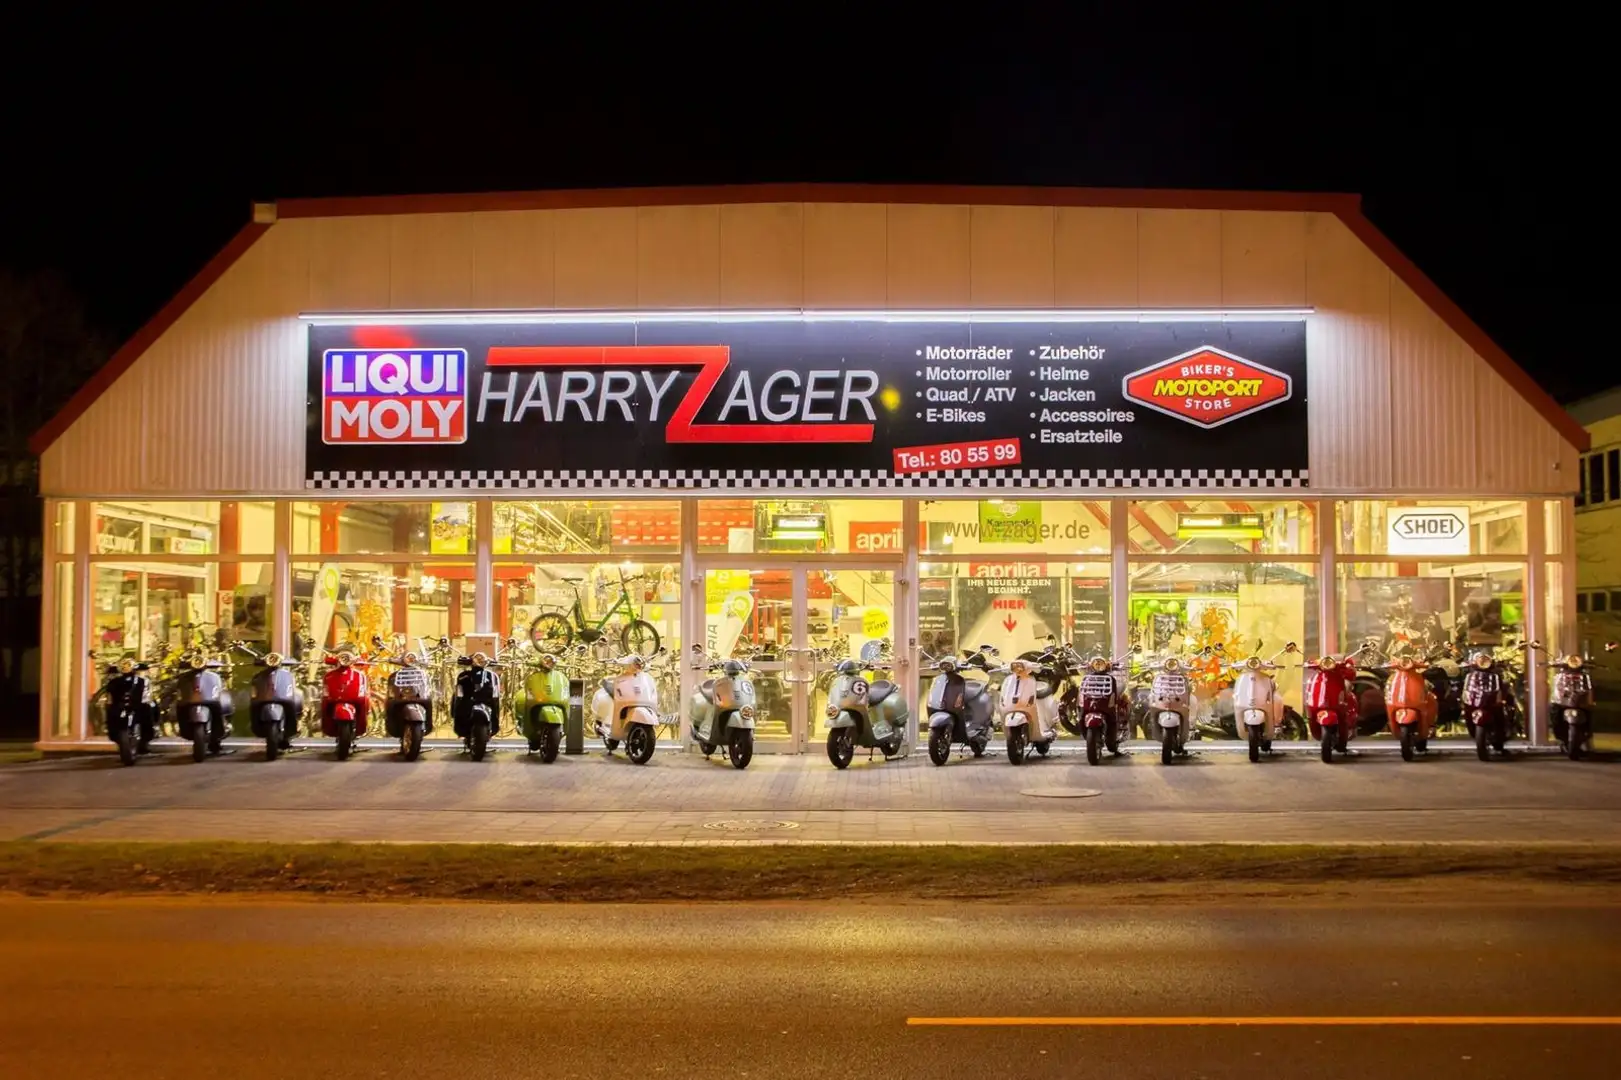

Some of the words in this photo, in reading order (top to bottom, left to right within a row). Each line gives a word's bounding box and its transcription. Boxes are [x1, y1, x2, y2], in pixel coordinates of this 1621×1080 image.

[926, 346, 1013, 360] Motorräder
[1039, 345, 1105, 360] Zubehör
[331, 353, 459, 395] LIQUI
[926, 366, 1012, 380] Motorroller
[1040, 366, 1090, 380] Helme
[1181, 364, 1234, 377] BIKER'S
[926, 387, 968, 402] Quad
[984, 387, 1016, 402] ATV
[1040, 387, 1096, 401] Jacken
[1152, 379, 1263, 397] MOTOPORT
[476, 370, 680, 423] HARRY
[1184, 398, 1232, 410] STORE
[331, 399, 463, 439] MOLY
[926, 408, 986, 422] E-Bikes
[1039, 408, 1135, 422] Accessoires
[1040, 429, 1123, 443] Ersatzteile
[897, 451, 936, 469] Tel.:
[940, 448, 962, 465] 80
[967, 446, 989, 463] 55
[993, 443, 1016, 460] 99
[944, 519, 1090, 544] www.zager.de
[1403, 518, 1454, 534] SHOEI
[855, 527, 903, 552] april
[976, 561, 1041, 578] aprilia
[967, 579, 984, 587] IHR
[987, 579, 1018, 587] NEUES
[1021, 579, 1051, 587] LEBEN
[992, 599, 1027, 610] HIER
